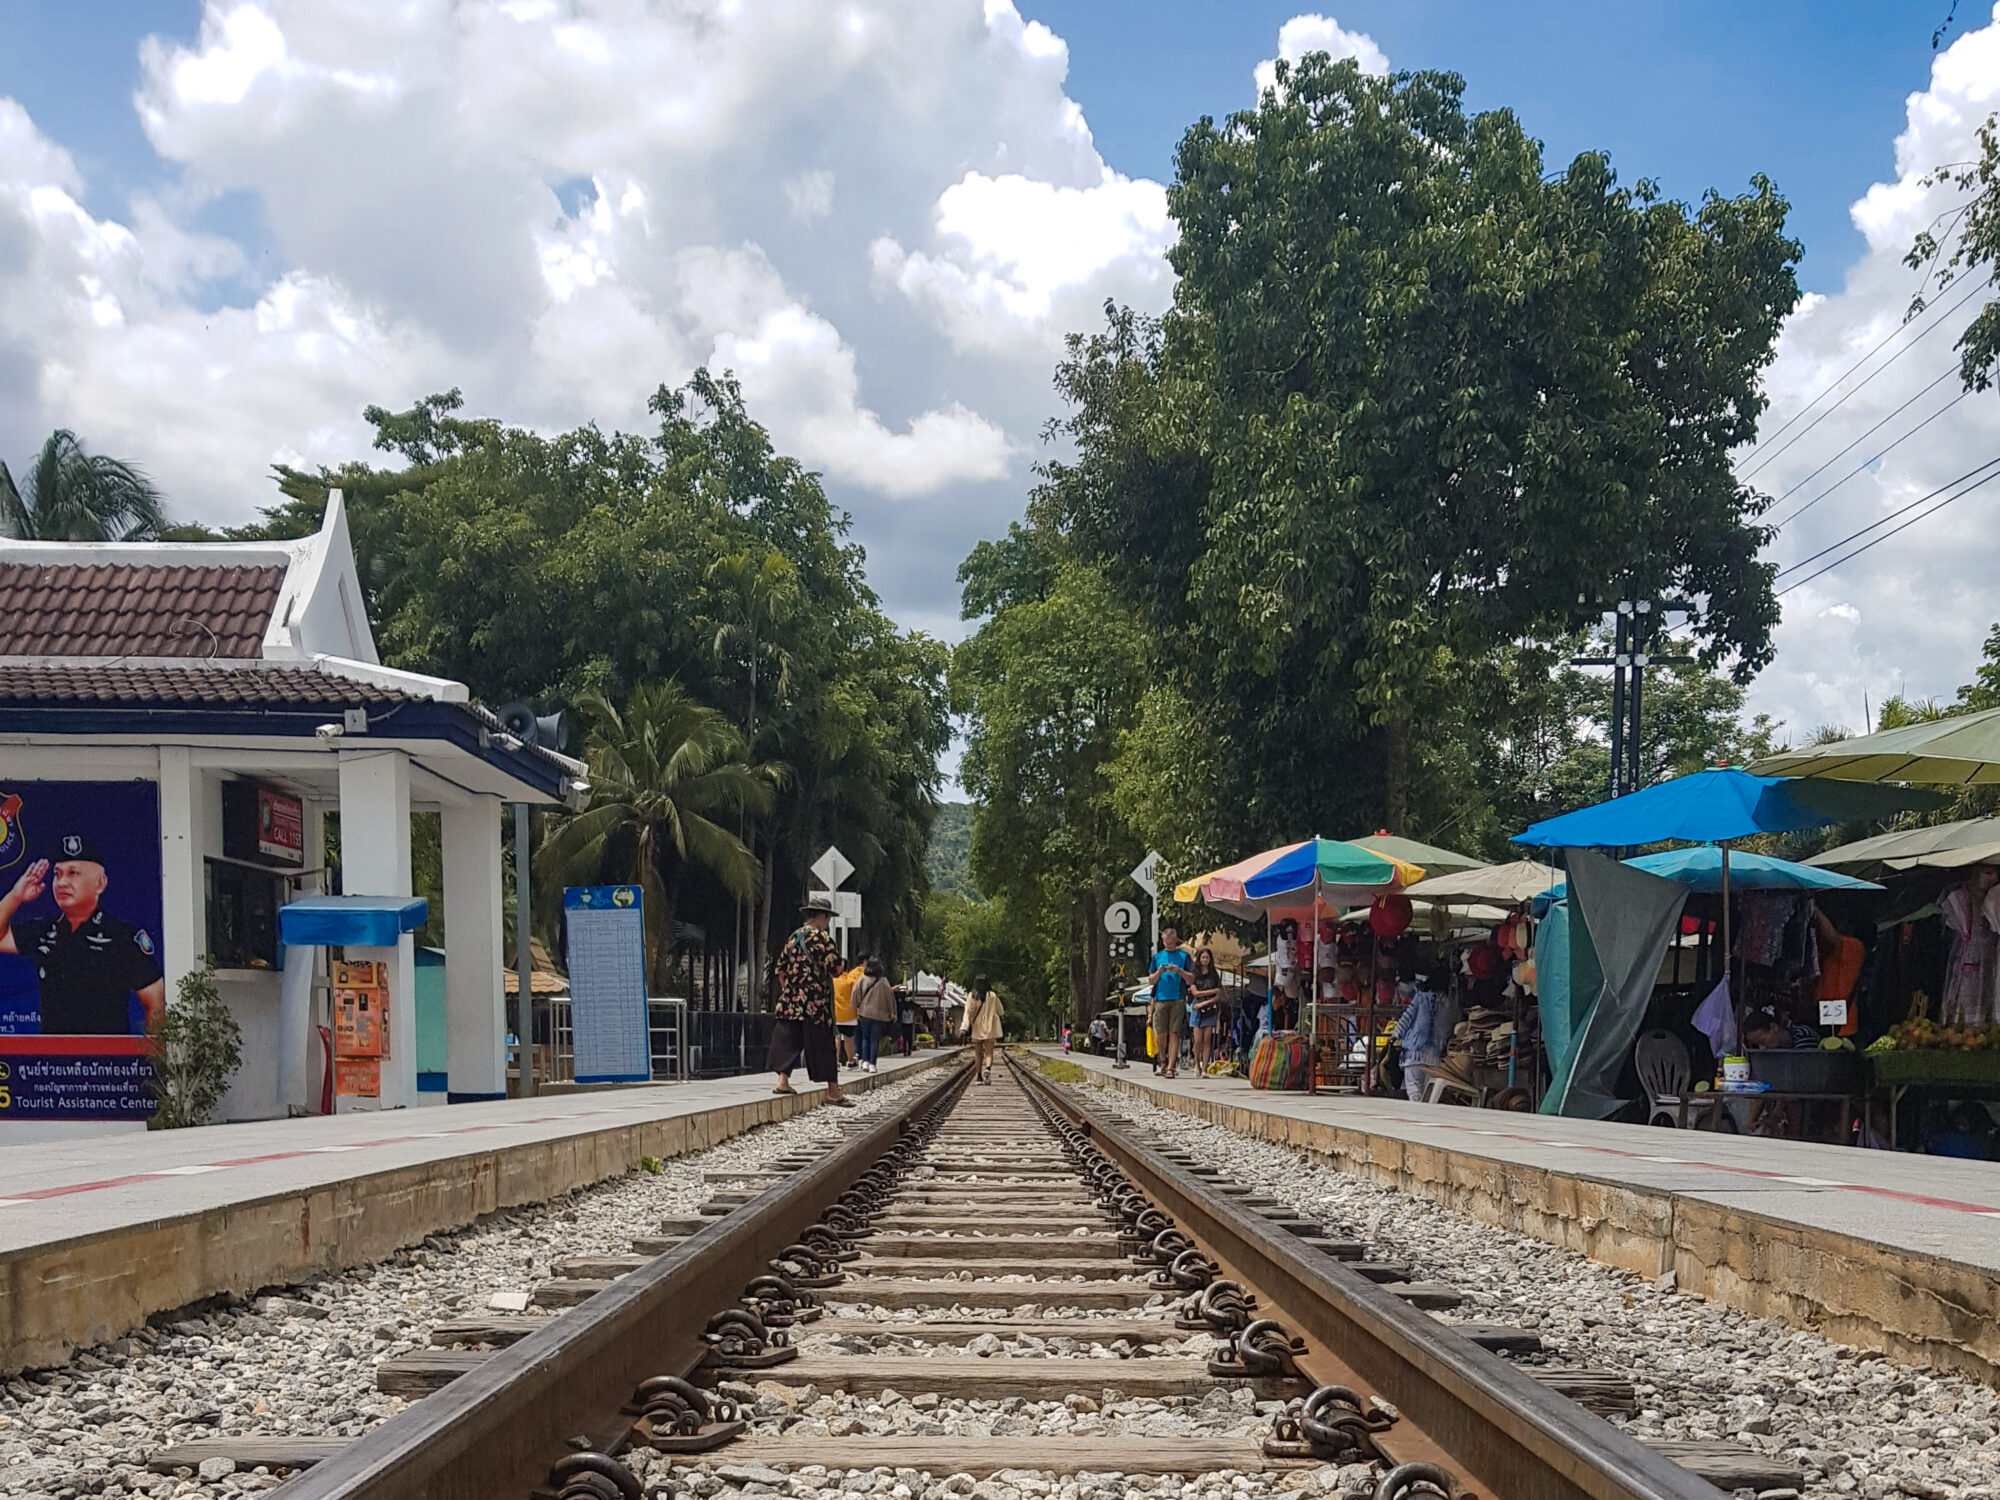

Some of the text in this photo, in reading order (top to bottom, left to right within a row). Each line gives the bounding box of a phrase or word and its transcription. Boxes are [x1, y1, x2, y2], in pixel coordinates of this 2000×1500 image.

[1611, 767, 1619, 798] 120
[273, 827, 288, 843] CALL
[1114, 908, 1130, 929] ว
[1823, 1004, 1843, 1018] 25
[18, 1058, 153, 1080] ศูนย์ช่วยเหลือนักท่องเที่ยว
[0, 1086, 11, 1108] 5
[15, 1096, 159, 1109] Tourist Assistance Center
